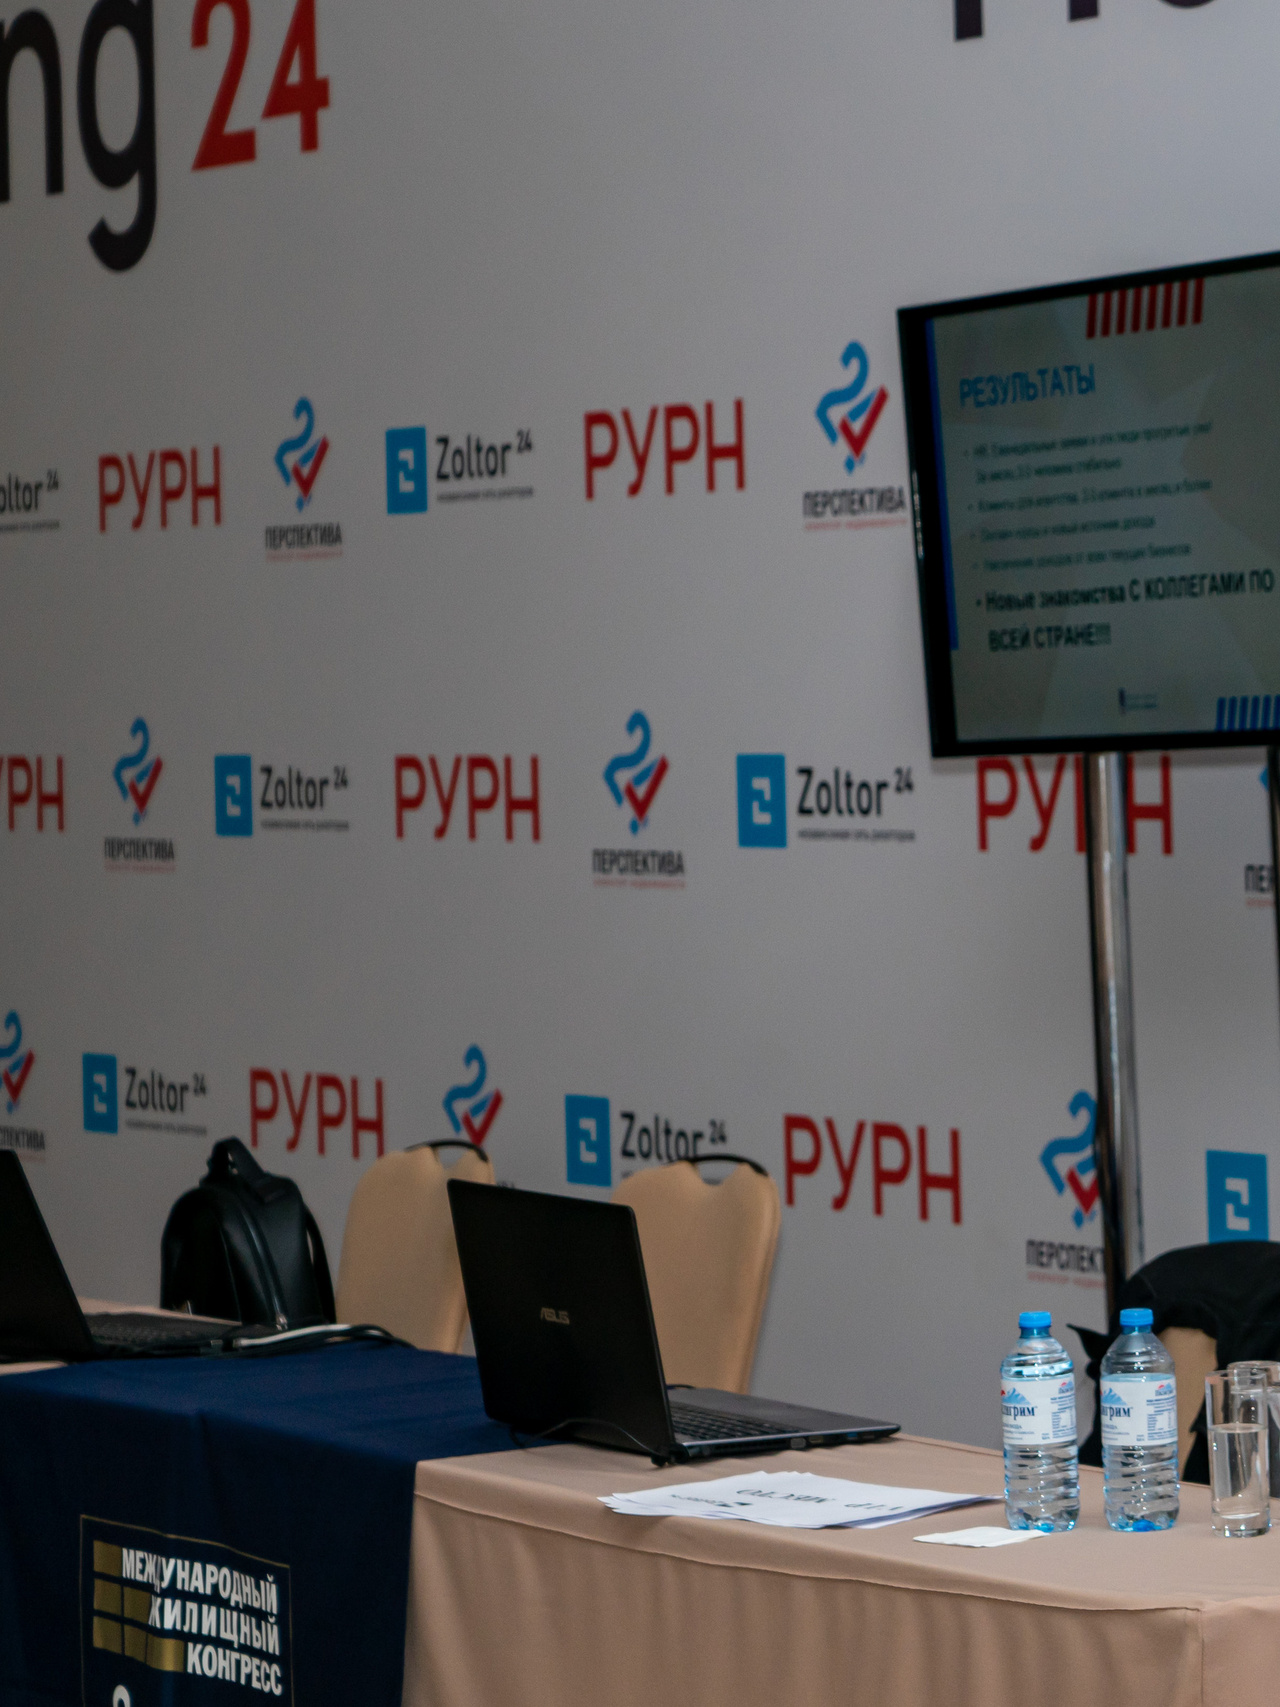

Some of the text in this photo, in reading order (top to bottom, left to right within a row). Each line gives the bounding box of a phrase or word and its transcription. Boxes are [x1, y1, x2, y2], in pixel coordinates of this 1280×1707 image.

[0, 0, 329, 273] ng 24
[959, 364, 1096, 410] РЕЗУЛЬТАТЫ
[437, 430, 533, 481] Zoltor 24
[584, 397, 745, 501] РУРН
[99, 446, 221, 532] РУРН
[803, 487, 906, 518] ПЕРСПЕКТИВА
[265, 523, 343, 550] ПЕРСПЕКТИВА
[1145, 572, 1246, 600] КОЛЛЕГАМИ
[1249, 568, 1275, 593] ПО
[988, 623, 1030, 651] ВСЕЙ
[260, 765, 348, 810] Zoltor 24
[394, 755, 540, 842] РУРН
[797, 767, 914, 816] Zoltor 24
[104, 838, 175, 862] ПЕРСПЕКТИВА
[592, 848, 685, 875] ПЕРСПЕКТИВА
[125, 1066, 189, 1112] Zoltor
[249, 1068, 386, 1159] РУРН
[621, 1111, 704, 1161] Zoltor
[784, 1114, 961, 1225] РУРН
[122, 1547, 278, 1615] МЕЖДУНАРОДНЫЙ
[148, 1594, 280, 1656] ЖИЛИЩНЫЙ
[187, 1641, 282, 1696] КОНГРЕСС
